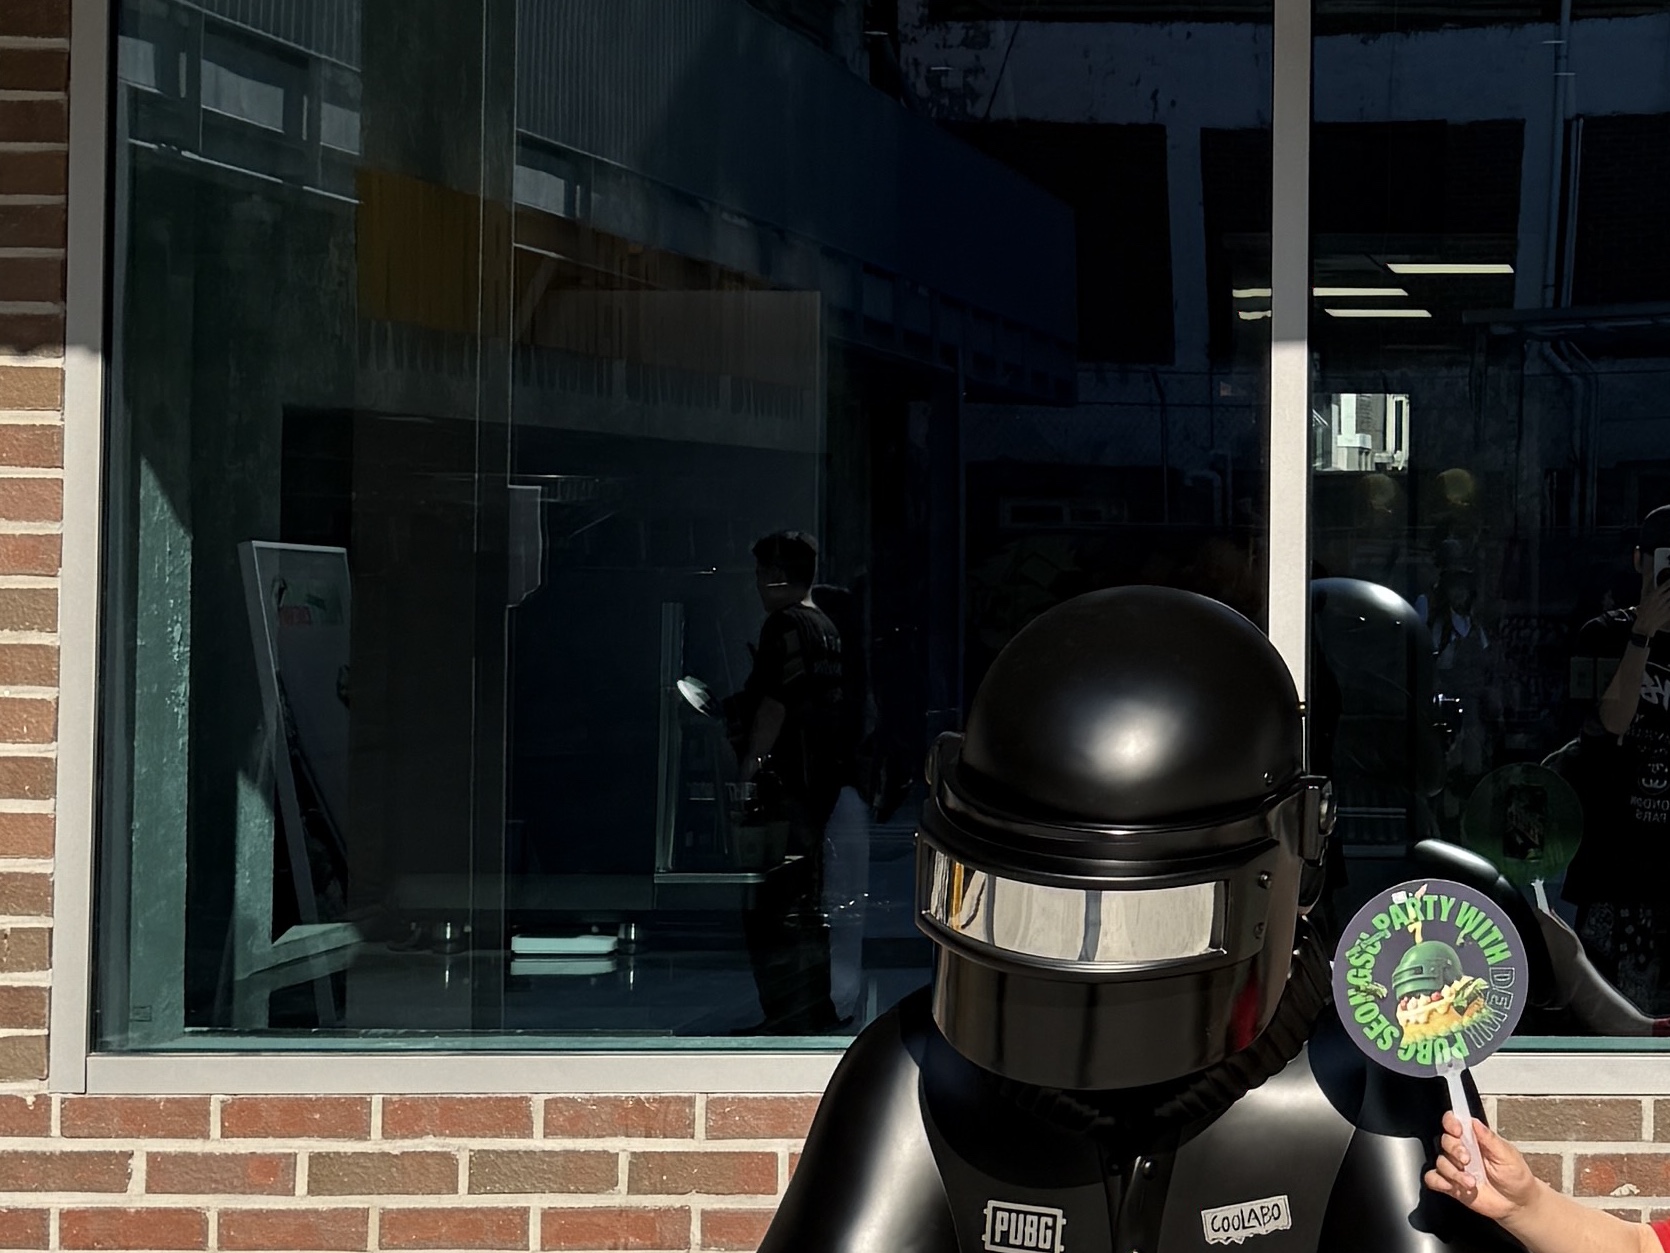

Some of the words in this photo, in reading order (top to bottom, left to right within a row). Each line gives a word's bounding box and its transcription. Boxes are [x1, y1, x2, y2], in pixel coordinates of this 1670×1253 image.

[1372, 895, 1455, 930] PARTY
[1455, 901, 1512, 965] WITH
[1397, 1031, 1470, 1066] PUBG
[994, 1211, 1053, 1249] PUBG
[1211, 1203, 1281, 1233] COOLABO
